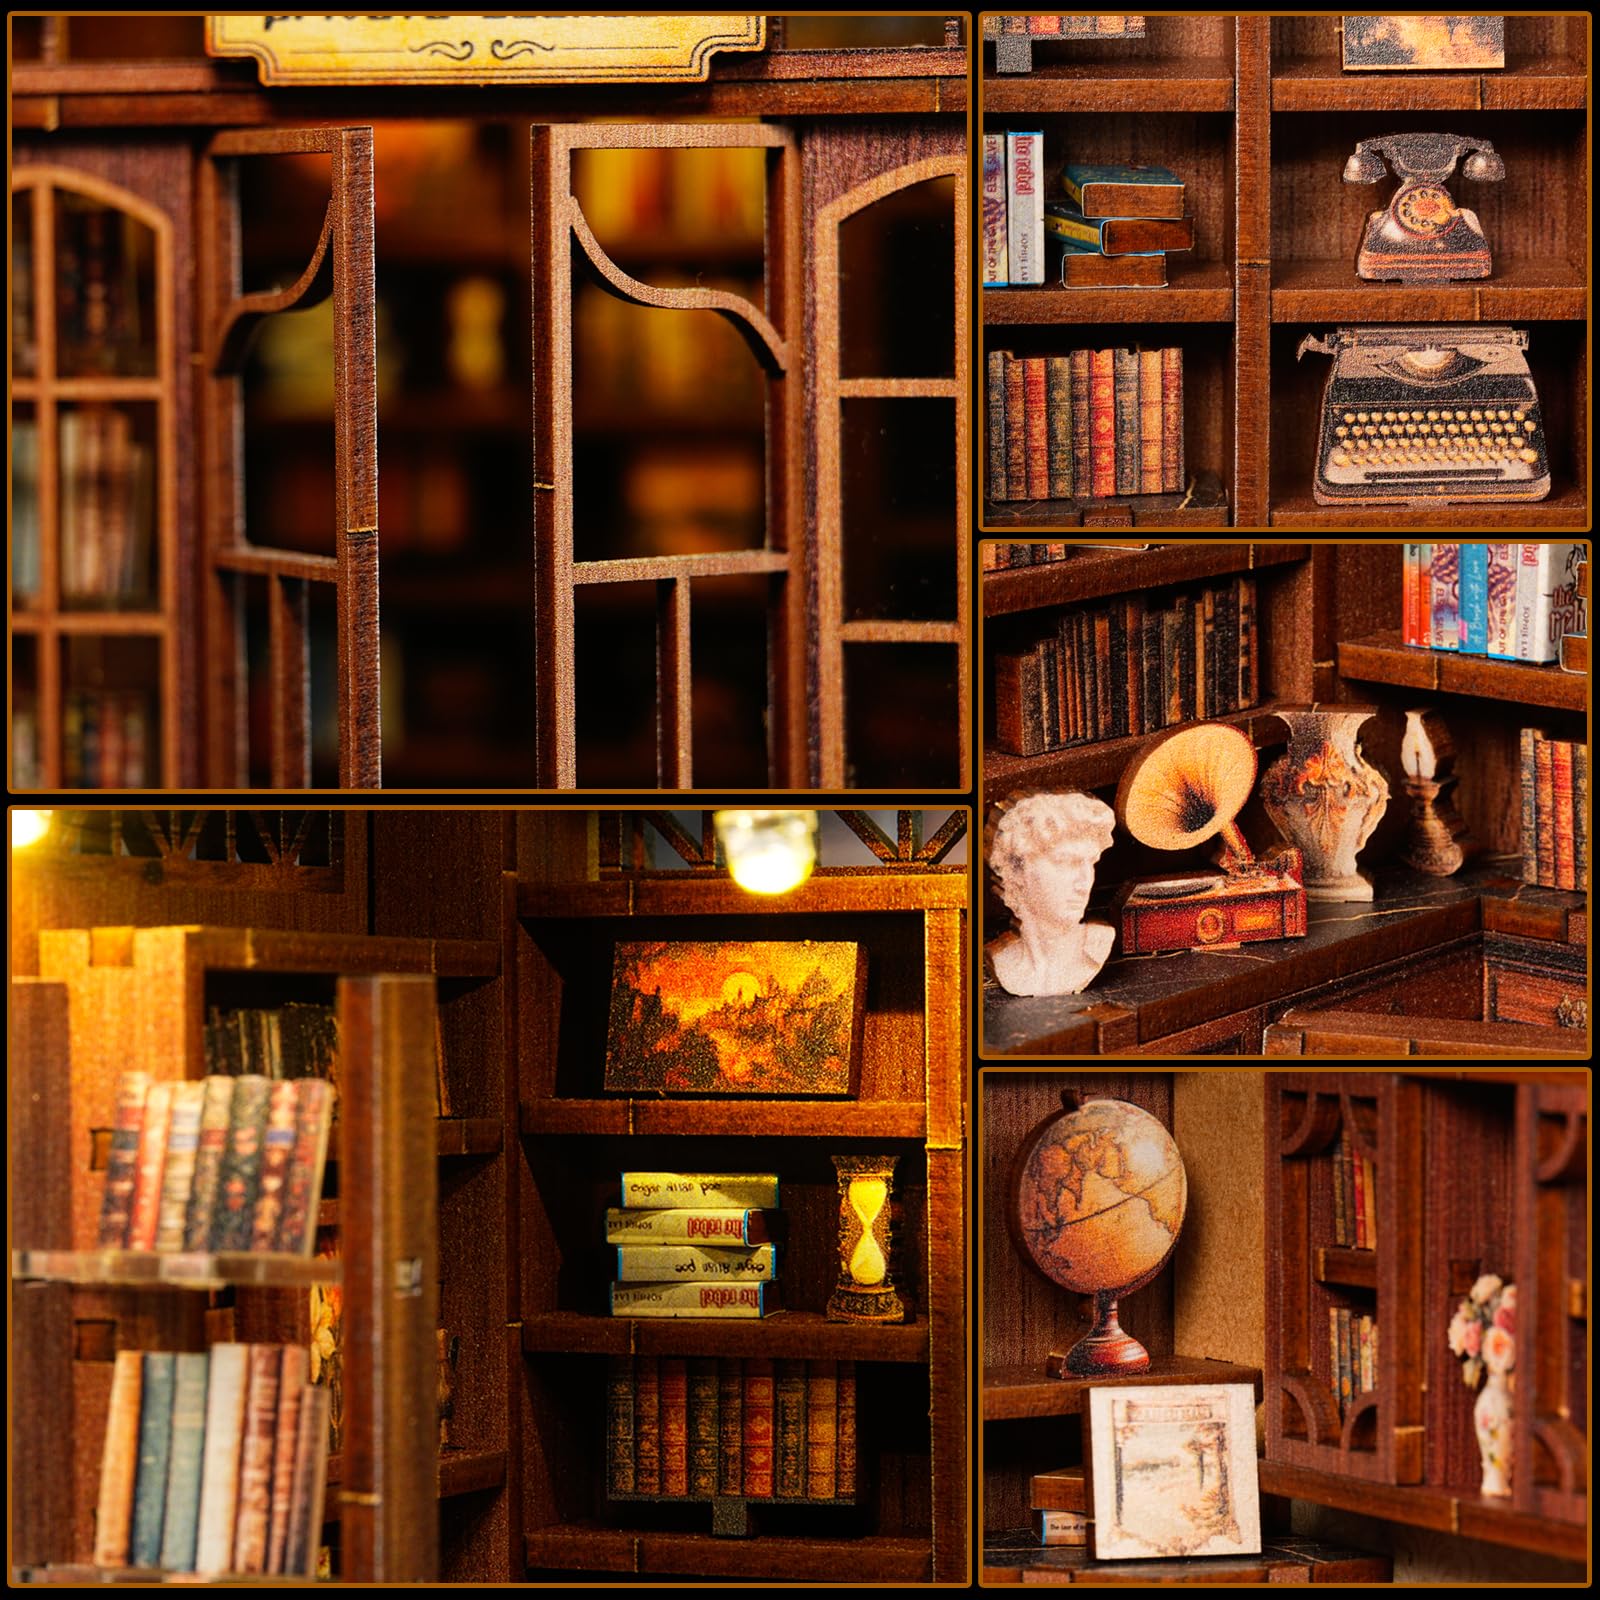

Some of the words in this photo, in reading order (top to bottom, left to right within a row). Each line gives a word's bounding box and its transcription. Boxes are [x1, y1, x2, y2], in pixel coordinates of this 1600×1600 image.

[1015, 158, 1035, 195] rebel
[687, 1218, 722, 1239] rebel
[699, 1288, 737, 1309] rebel
